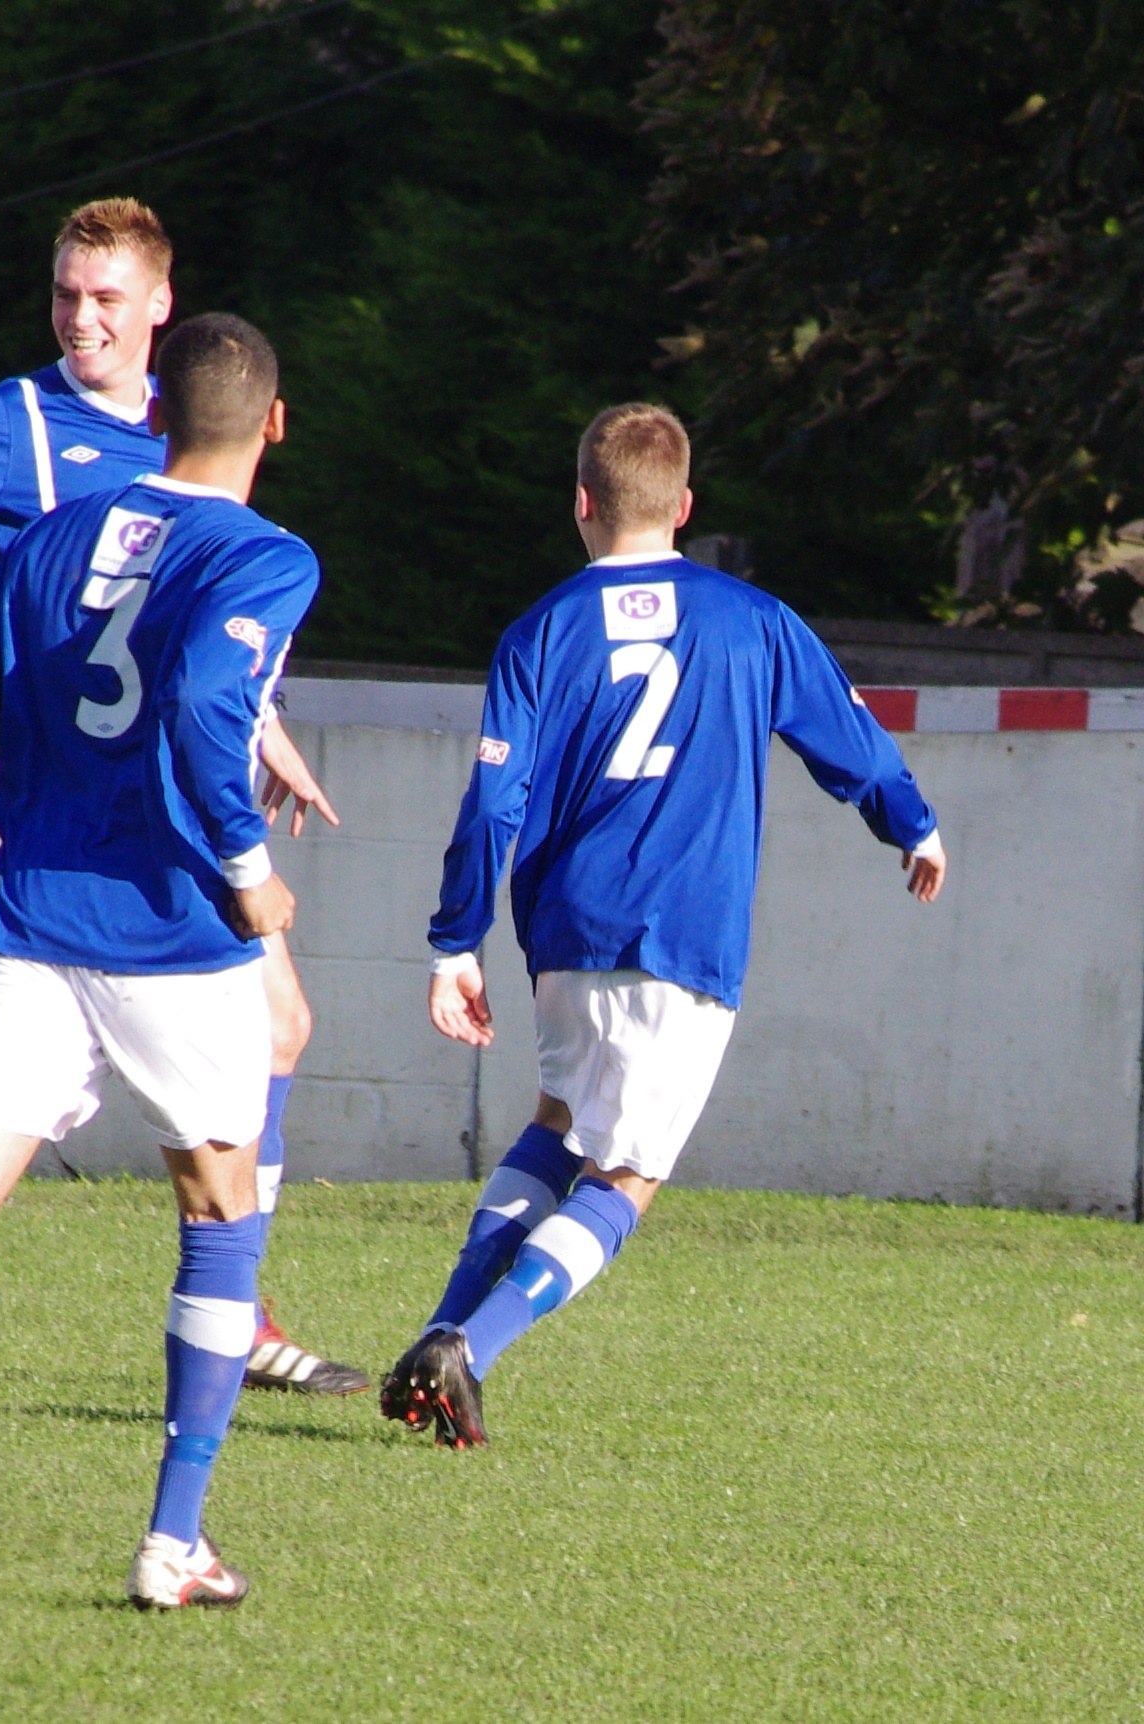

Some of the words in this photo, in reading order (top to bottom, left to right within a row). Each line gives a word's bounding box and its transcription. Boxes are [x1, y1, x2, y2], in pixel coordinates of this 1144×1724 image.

[74, 575, 150, 739] 3
[623, 593, 656, 617] HG
[605, 641, 679, 780] 2
